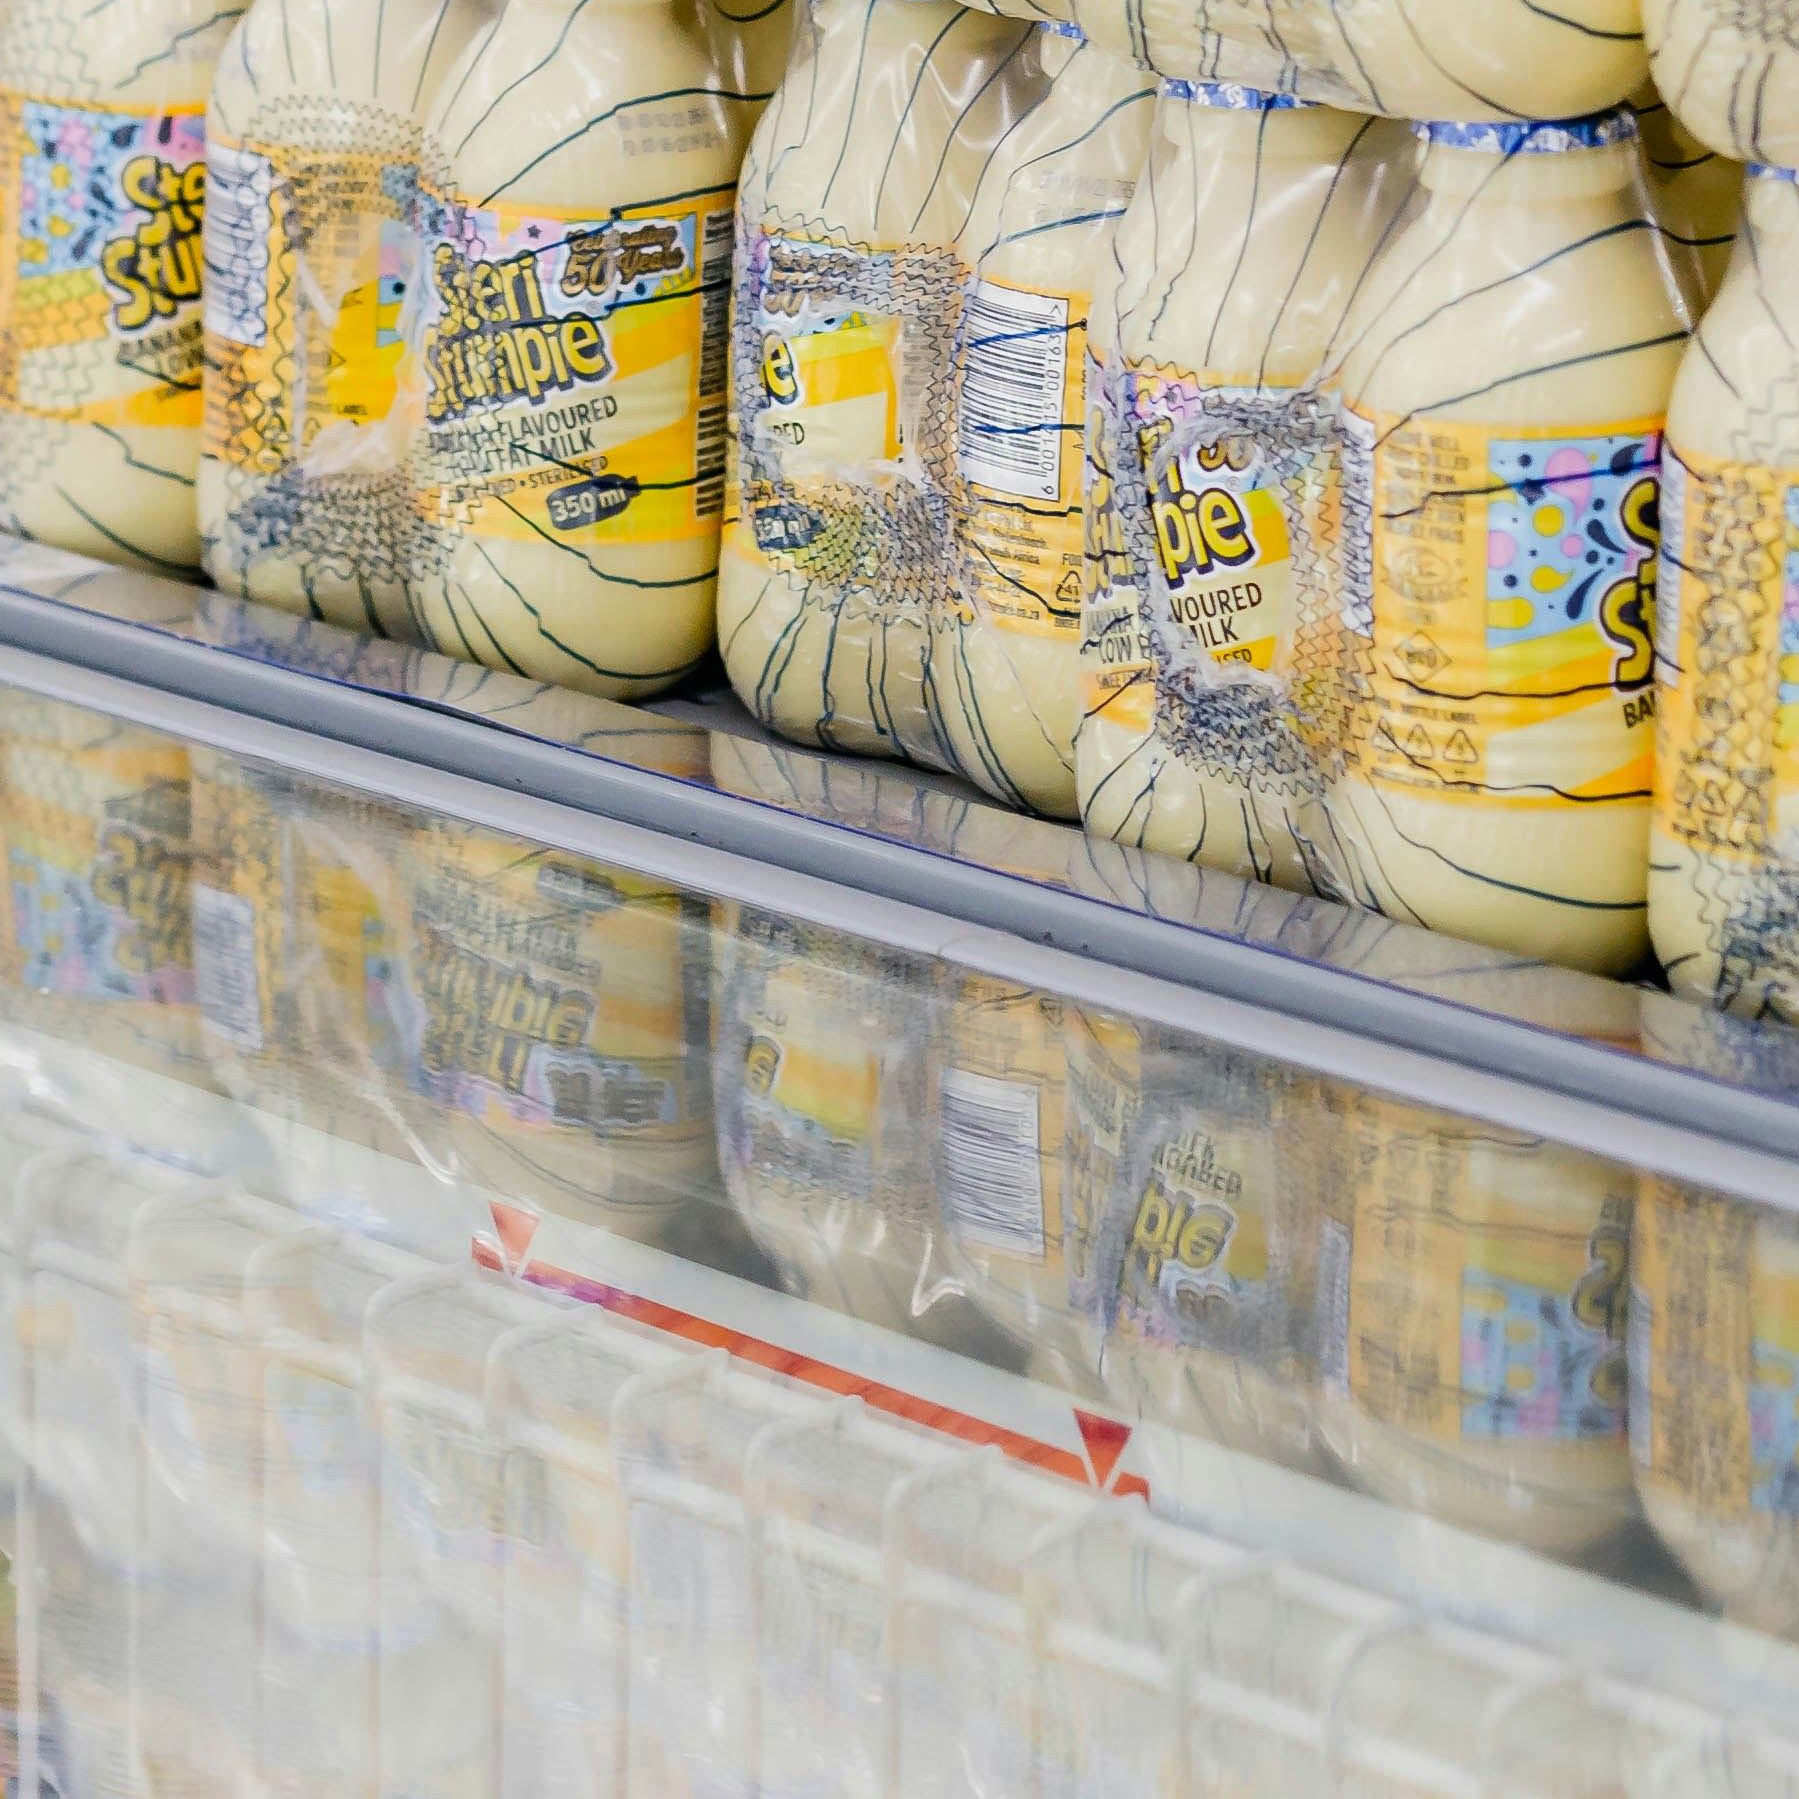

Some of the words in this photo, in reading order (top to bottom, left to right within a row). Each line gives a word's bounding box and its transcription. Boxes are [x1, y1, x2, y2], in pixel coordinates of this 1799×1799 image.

[498, 395, 618, 438] FLAVOURED
[538, 427, 598, 464] MILK
[551, 491, 597, 523] 350
[1170, 582, 1262, 624] VOURED
